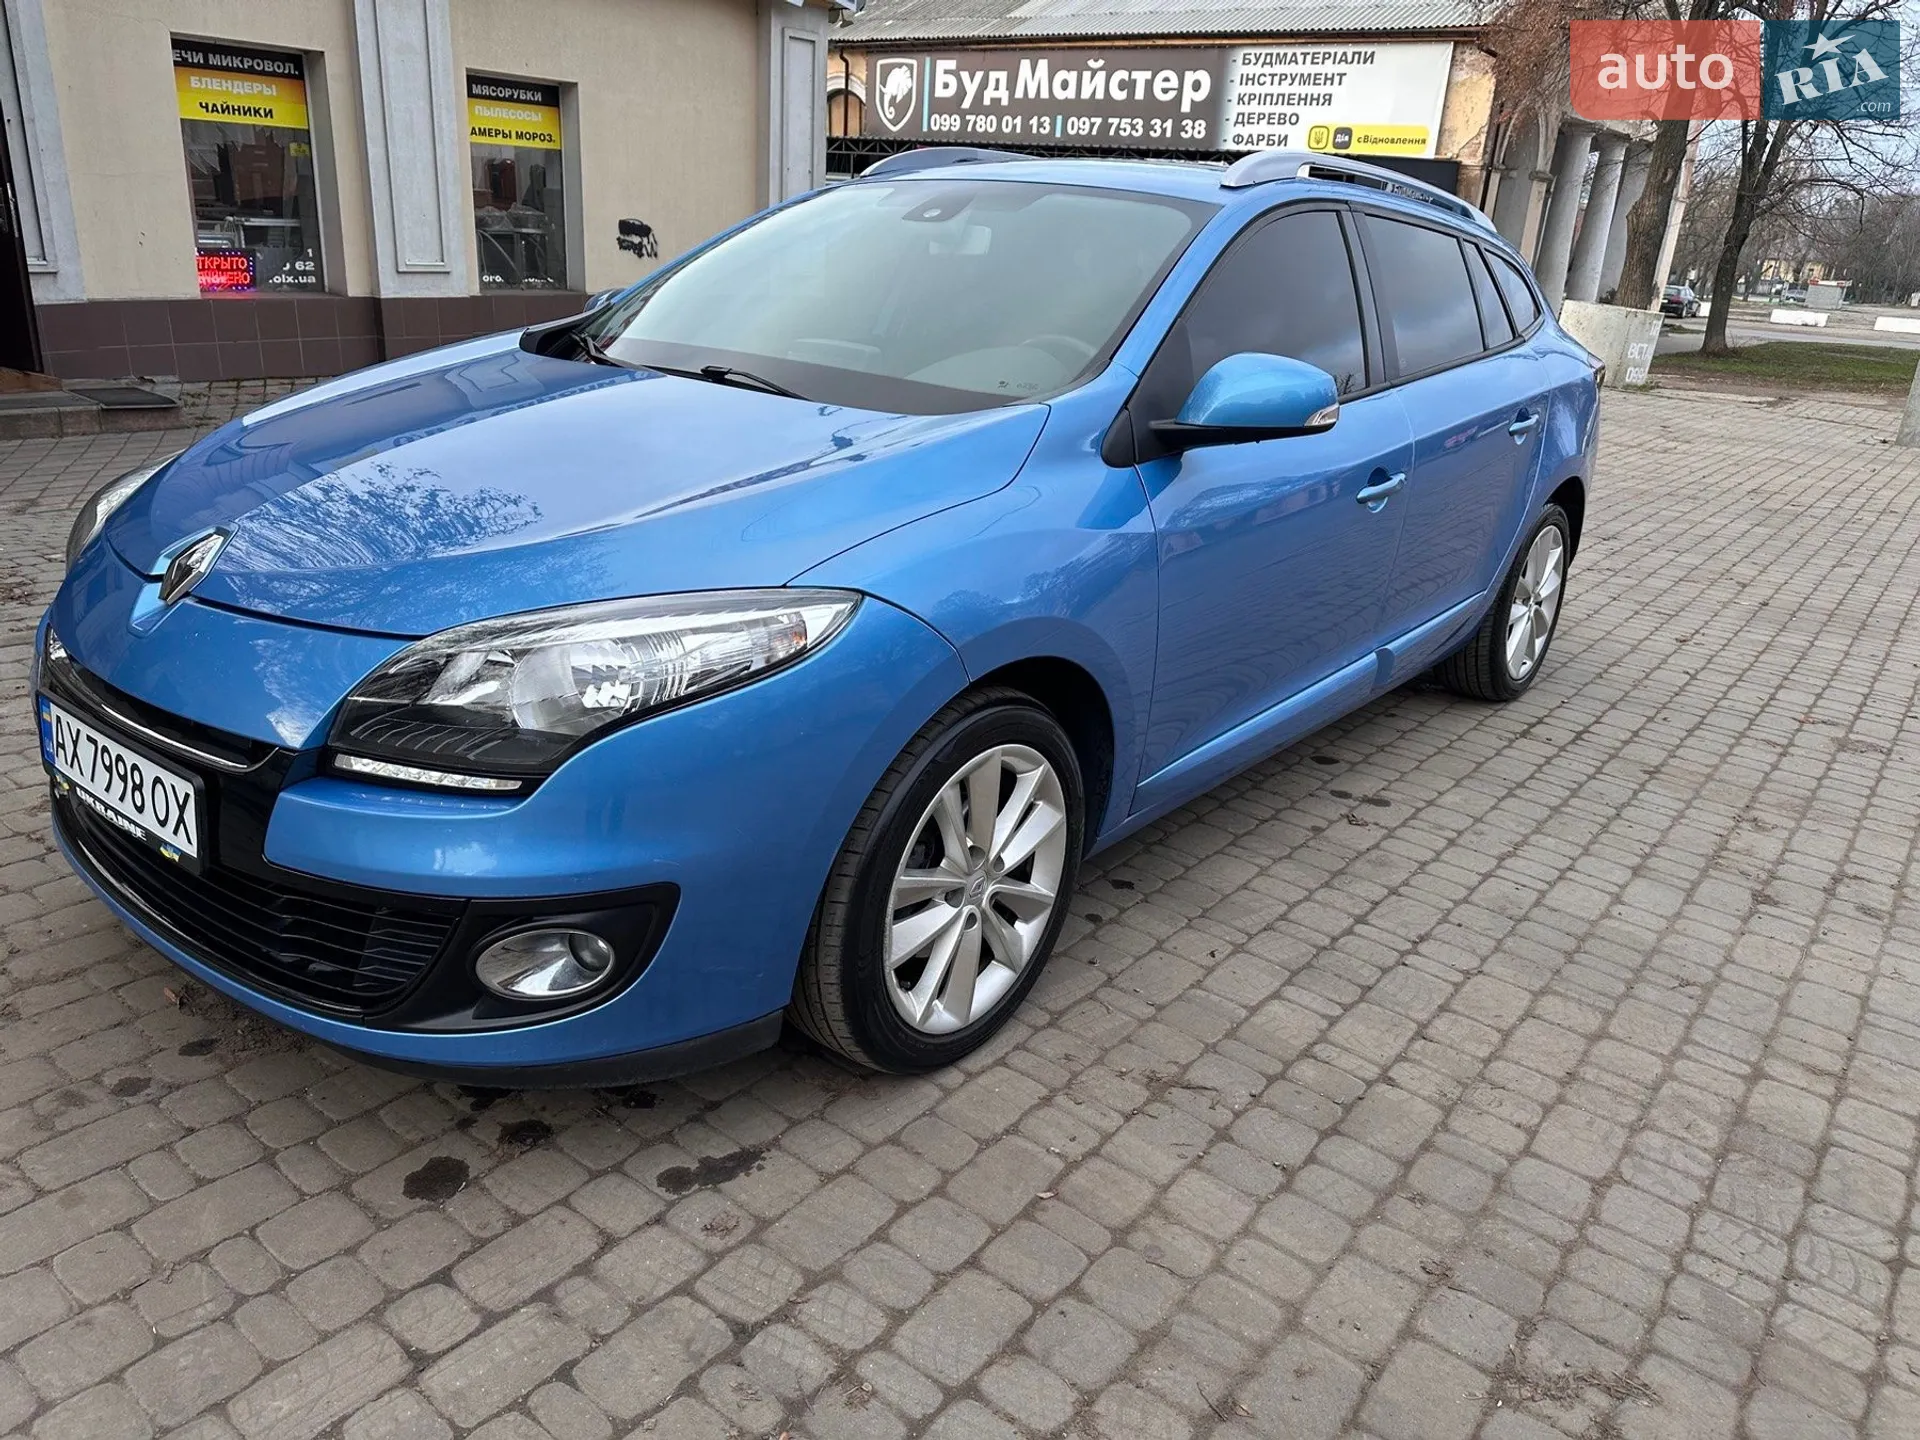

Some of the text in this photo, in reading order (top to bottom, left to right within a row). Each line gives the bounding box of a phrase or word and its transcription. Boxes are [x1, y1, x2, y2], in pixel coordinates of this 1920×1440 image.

[208, 53, 299, 75] МИКРОВОЛ.
[1241, 50, 1376, 68] БУДМАТЕРІАЛИ
[189, 76, 277, 96] БЛЕНДЕРЫ
[1239, 72, 1347, 87] ІНСТРУМЕНТ
[472, 84, 542, 102] МЯСОРУБКИ
[1236, 92, 1333, 107] КРІПЛЕННЯ
[198, 101, 273, 119] ЧАЙНИКИ
[474, 105, 542, 122] ПЫЛЕСОСЫ
[930, 113, 1207, 139] 099 780 01 13 097 753 31 38
[1233, 112, 1300, 128] ДЕРЕВО
[515, 130, 556, 143] МОРОЗ.
[1231, 133, 1289, 147] ФАРБИ
[54, 713, 85, 777] AX
[86, 733, 146, 814] 7998
[75, 786, 147, 842] UKRAINE
